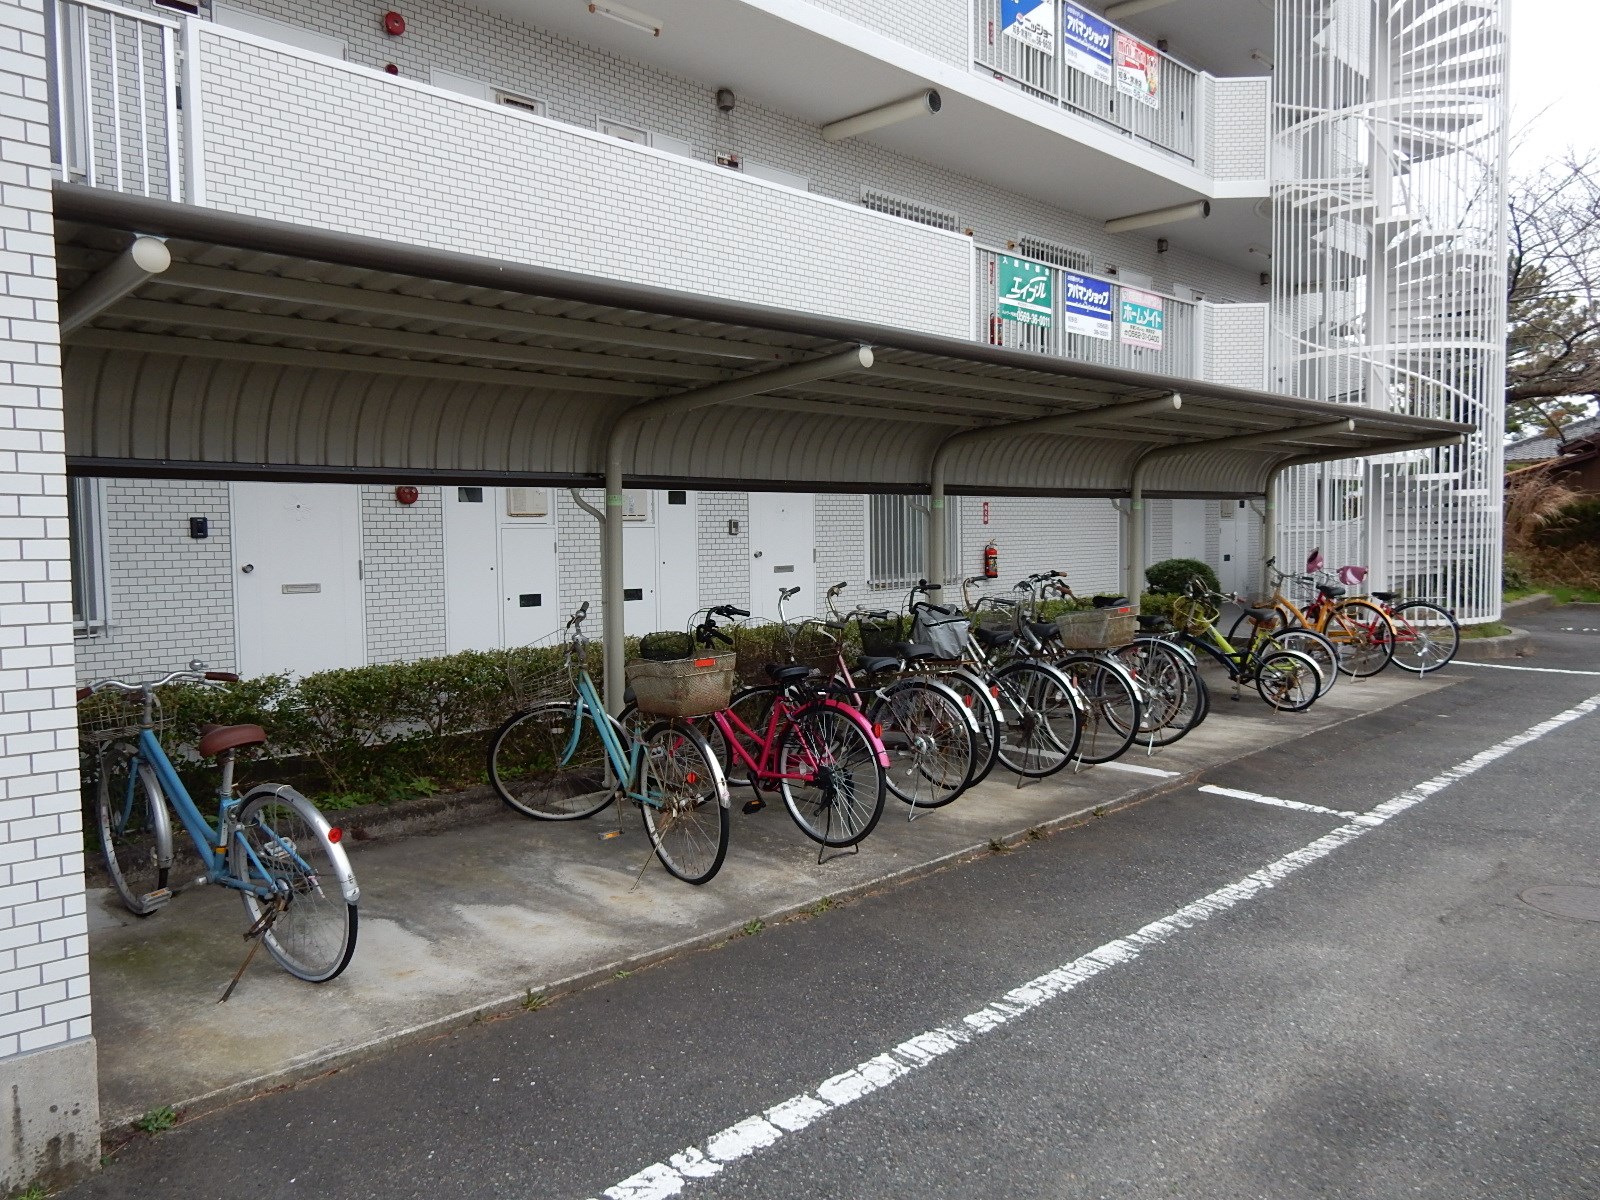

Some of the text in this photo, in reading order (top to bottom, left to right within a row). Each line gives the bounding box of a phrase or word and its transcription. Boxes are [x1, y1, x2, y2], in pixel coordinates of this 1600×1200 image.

[1024, 17, 1053, 39] ニッショー
[1067, 14, 1109, 49] アパマンショップ
[1006, 276, 1048, 303] エイブル
[1067, 282, 1109, 306] アパマンショップ
[1122, 303, 1162, 328] ホームメイト
